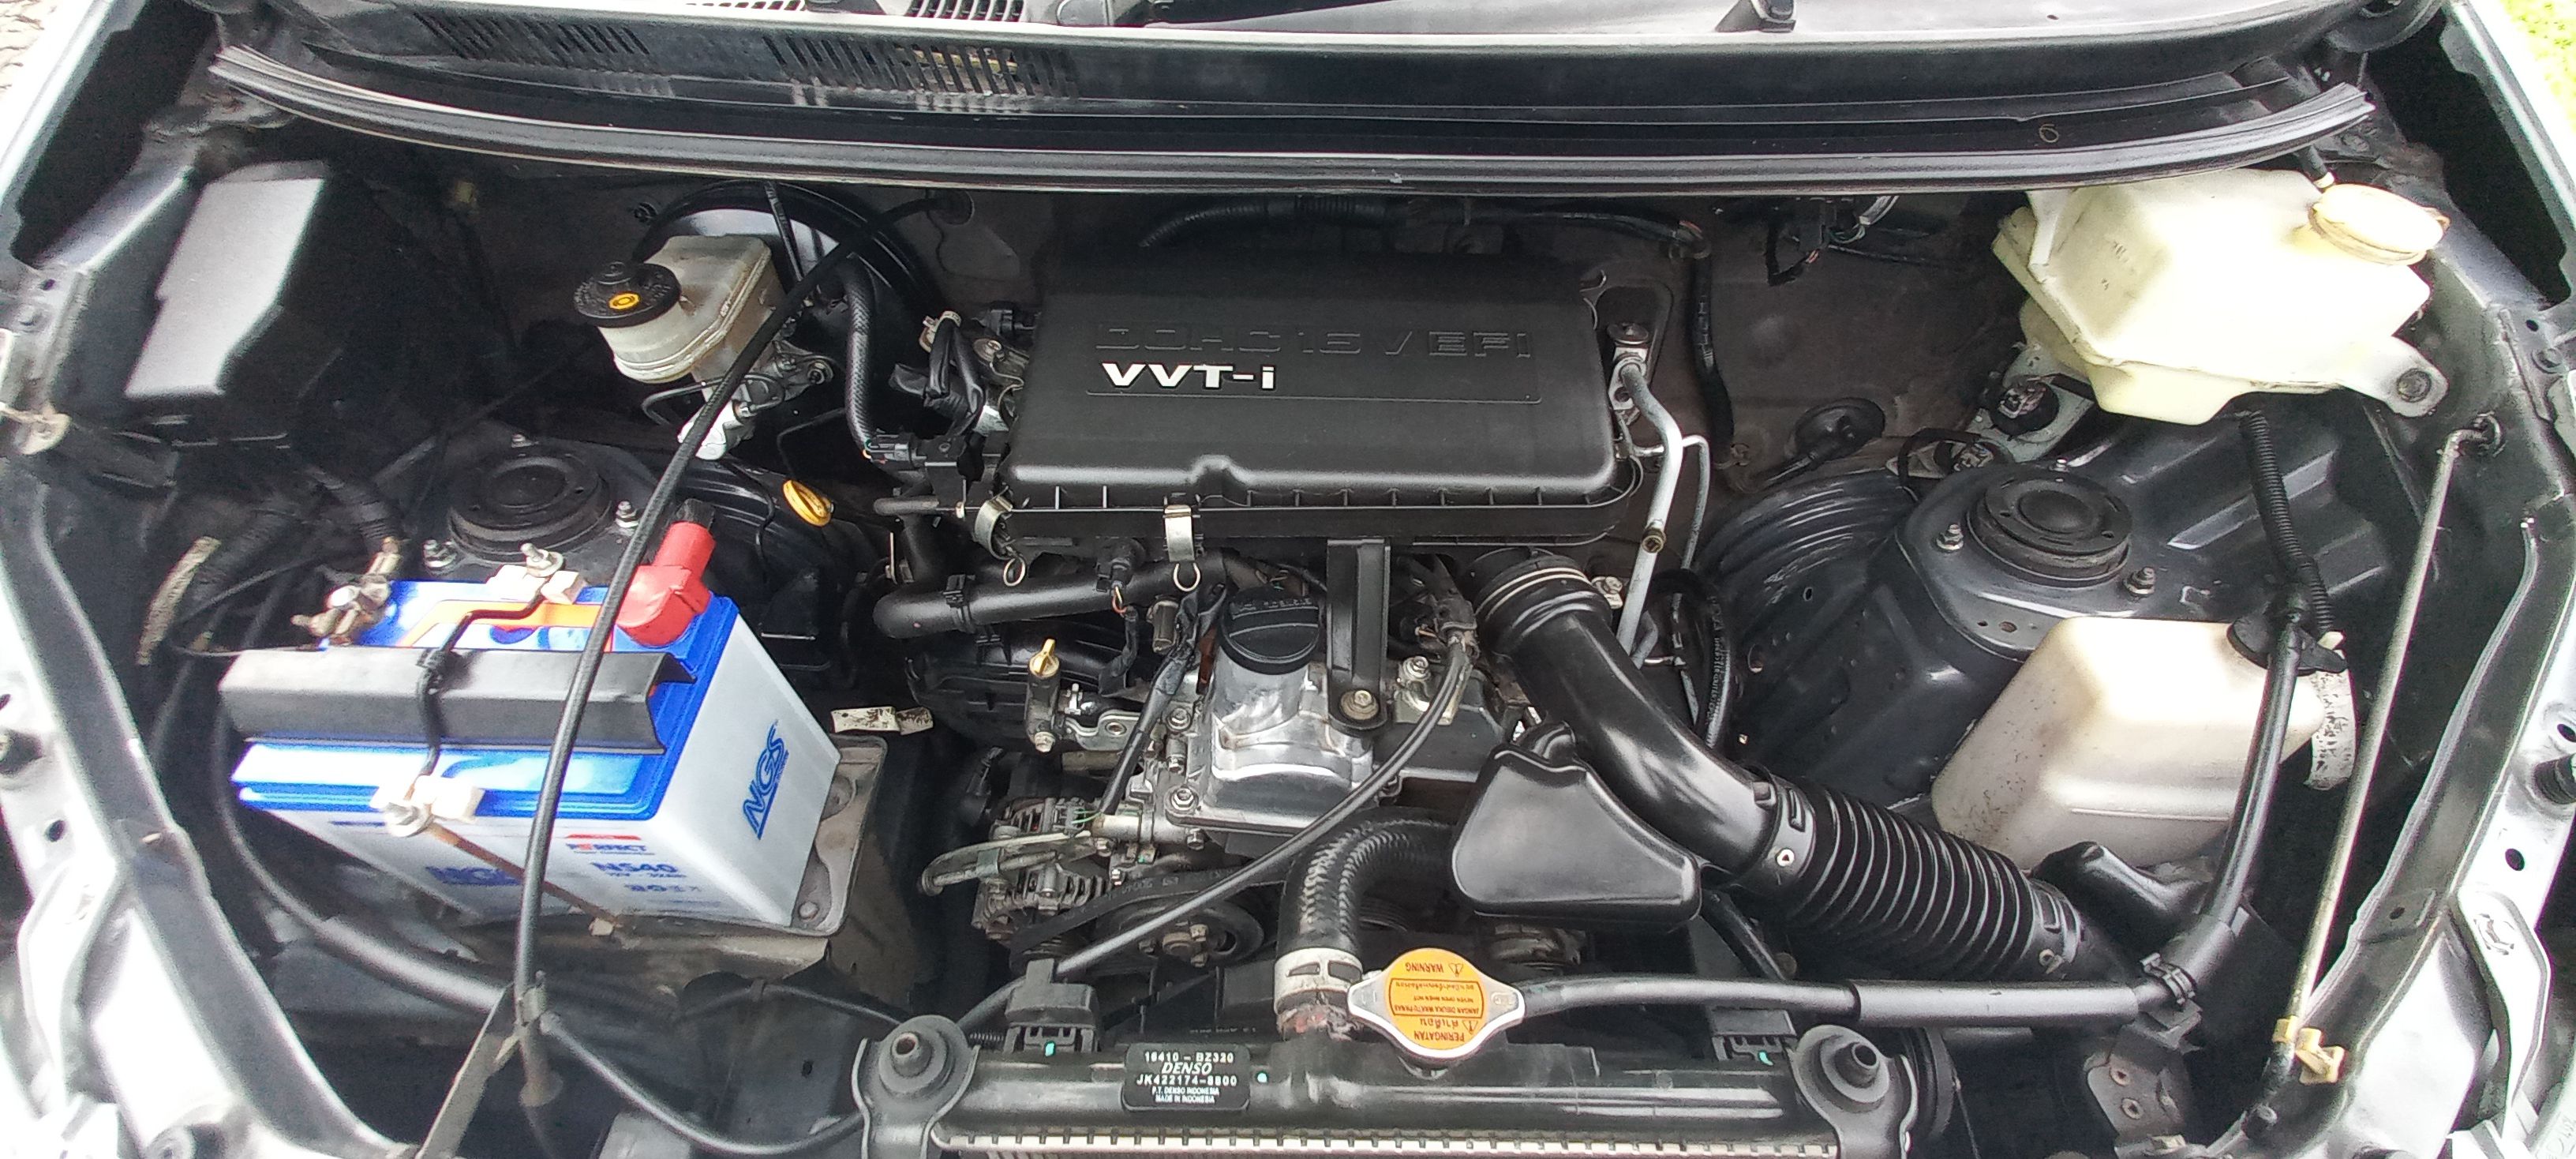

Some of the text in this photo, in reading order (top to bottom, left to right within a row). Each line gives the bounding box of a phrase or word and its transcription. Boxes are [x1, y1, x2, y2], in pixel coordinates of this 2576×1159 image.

[1428, 330, 1531, 358] EFI
[1101, 362, 1276, 390] VVT-i
[743, 722, 786, 840] NGS
[1405, 962, 1444, 973] WARNING
[1413, 1030, 1466, 1041] PERINGATAN
[1144, 1051, 1180, 1063] 16410
[1161, 1061, 1213, 1075] DENSO
[1163, 1086, 1185, 1095] DENSO
[1186, 1086, 1220, 1096] INDONESIA
[1155, 1094, 1174, 1103] MADE
[1181, 1095, 1215, 1104] INDONESIA
